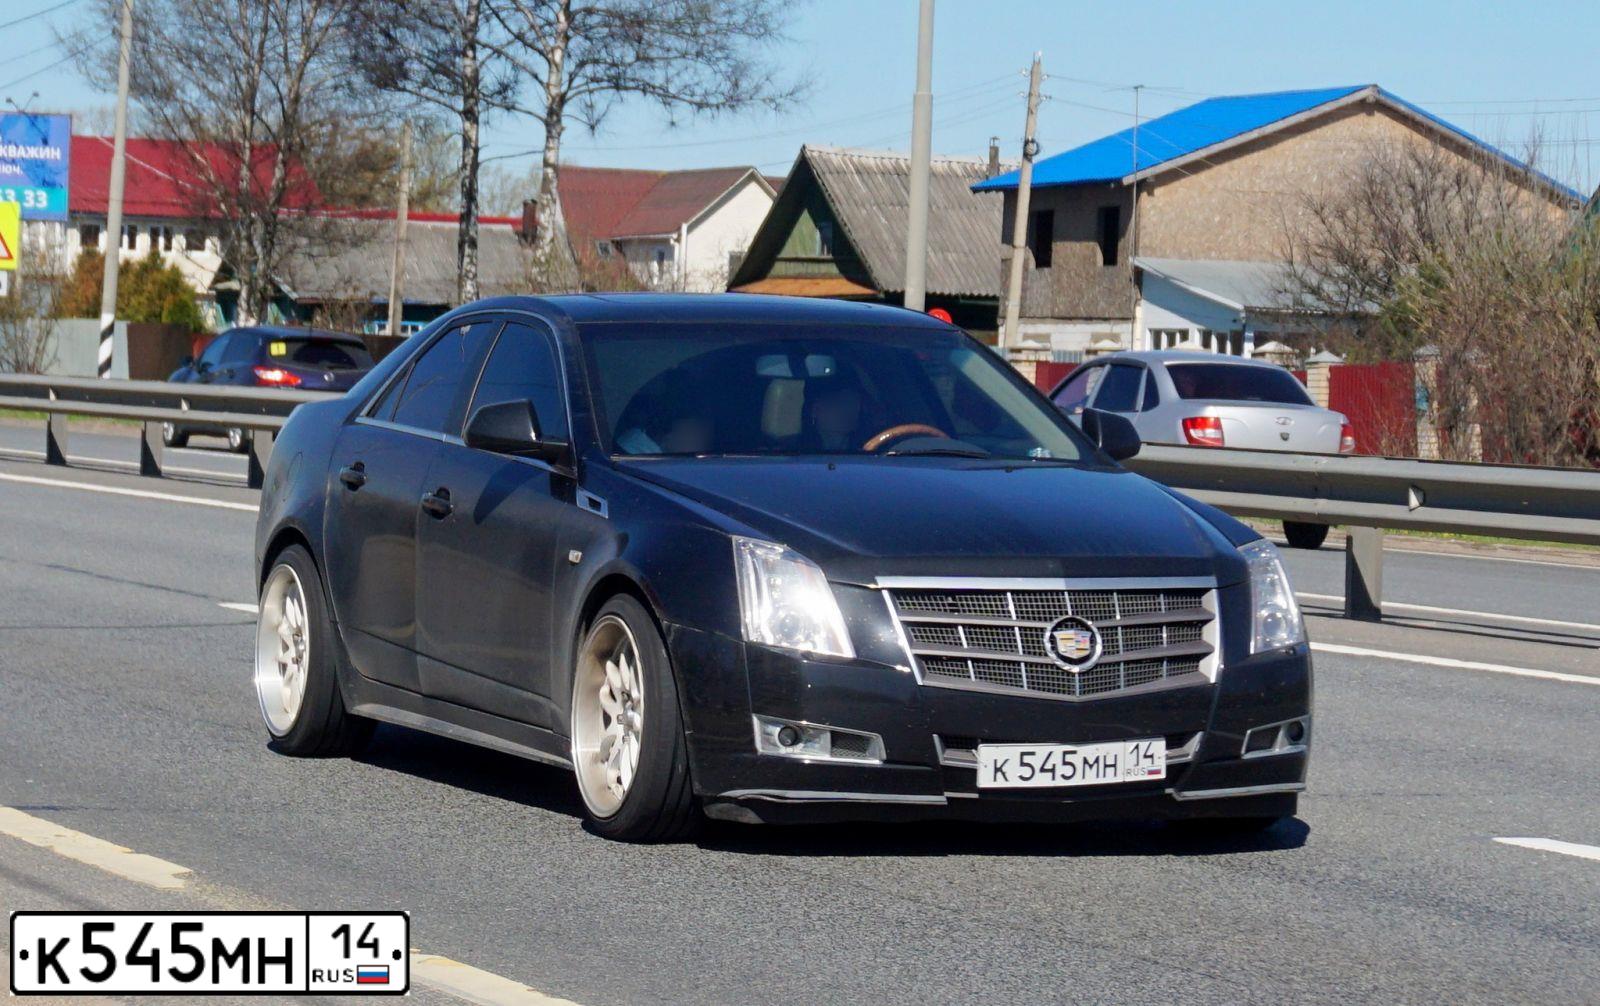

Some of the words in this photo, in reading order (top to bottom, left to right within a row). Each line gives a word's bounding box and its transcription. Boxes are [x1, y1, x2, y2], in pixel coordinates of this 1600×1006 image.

[0, 188, 15, 202] 3
[23, 189, 47, 208] 33
[1129, 742, 1155, 767] 14
[1126, 767, 1146, 776] RUS
